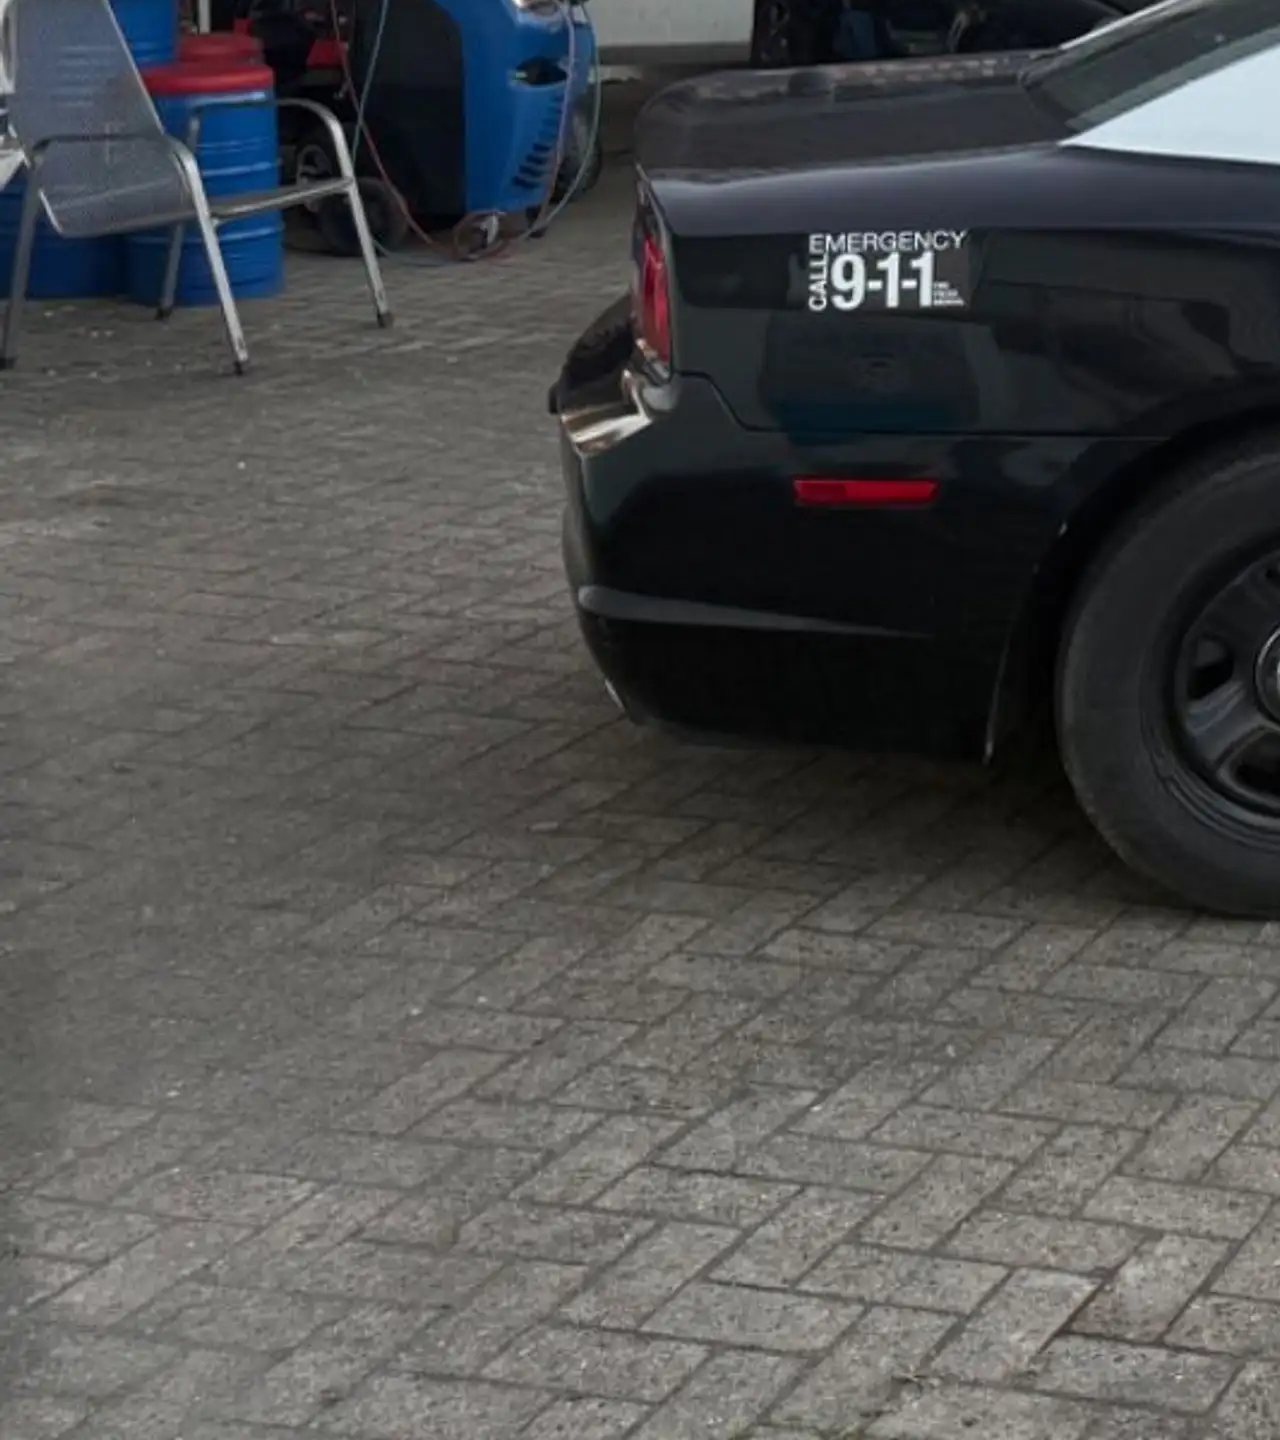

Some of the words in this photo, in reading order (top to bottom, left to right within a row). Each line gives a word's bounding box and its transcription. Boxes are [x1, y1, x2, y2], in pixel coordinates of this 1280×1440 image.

[808, 229, 967, 254] EMERGENCY
[808, 252, 828, 311] CALL
[830, 251, 934, 310] 9-1-1
